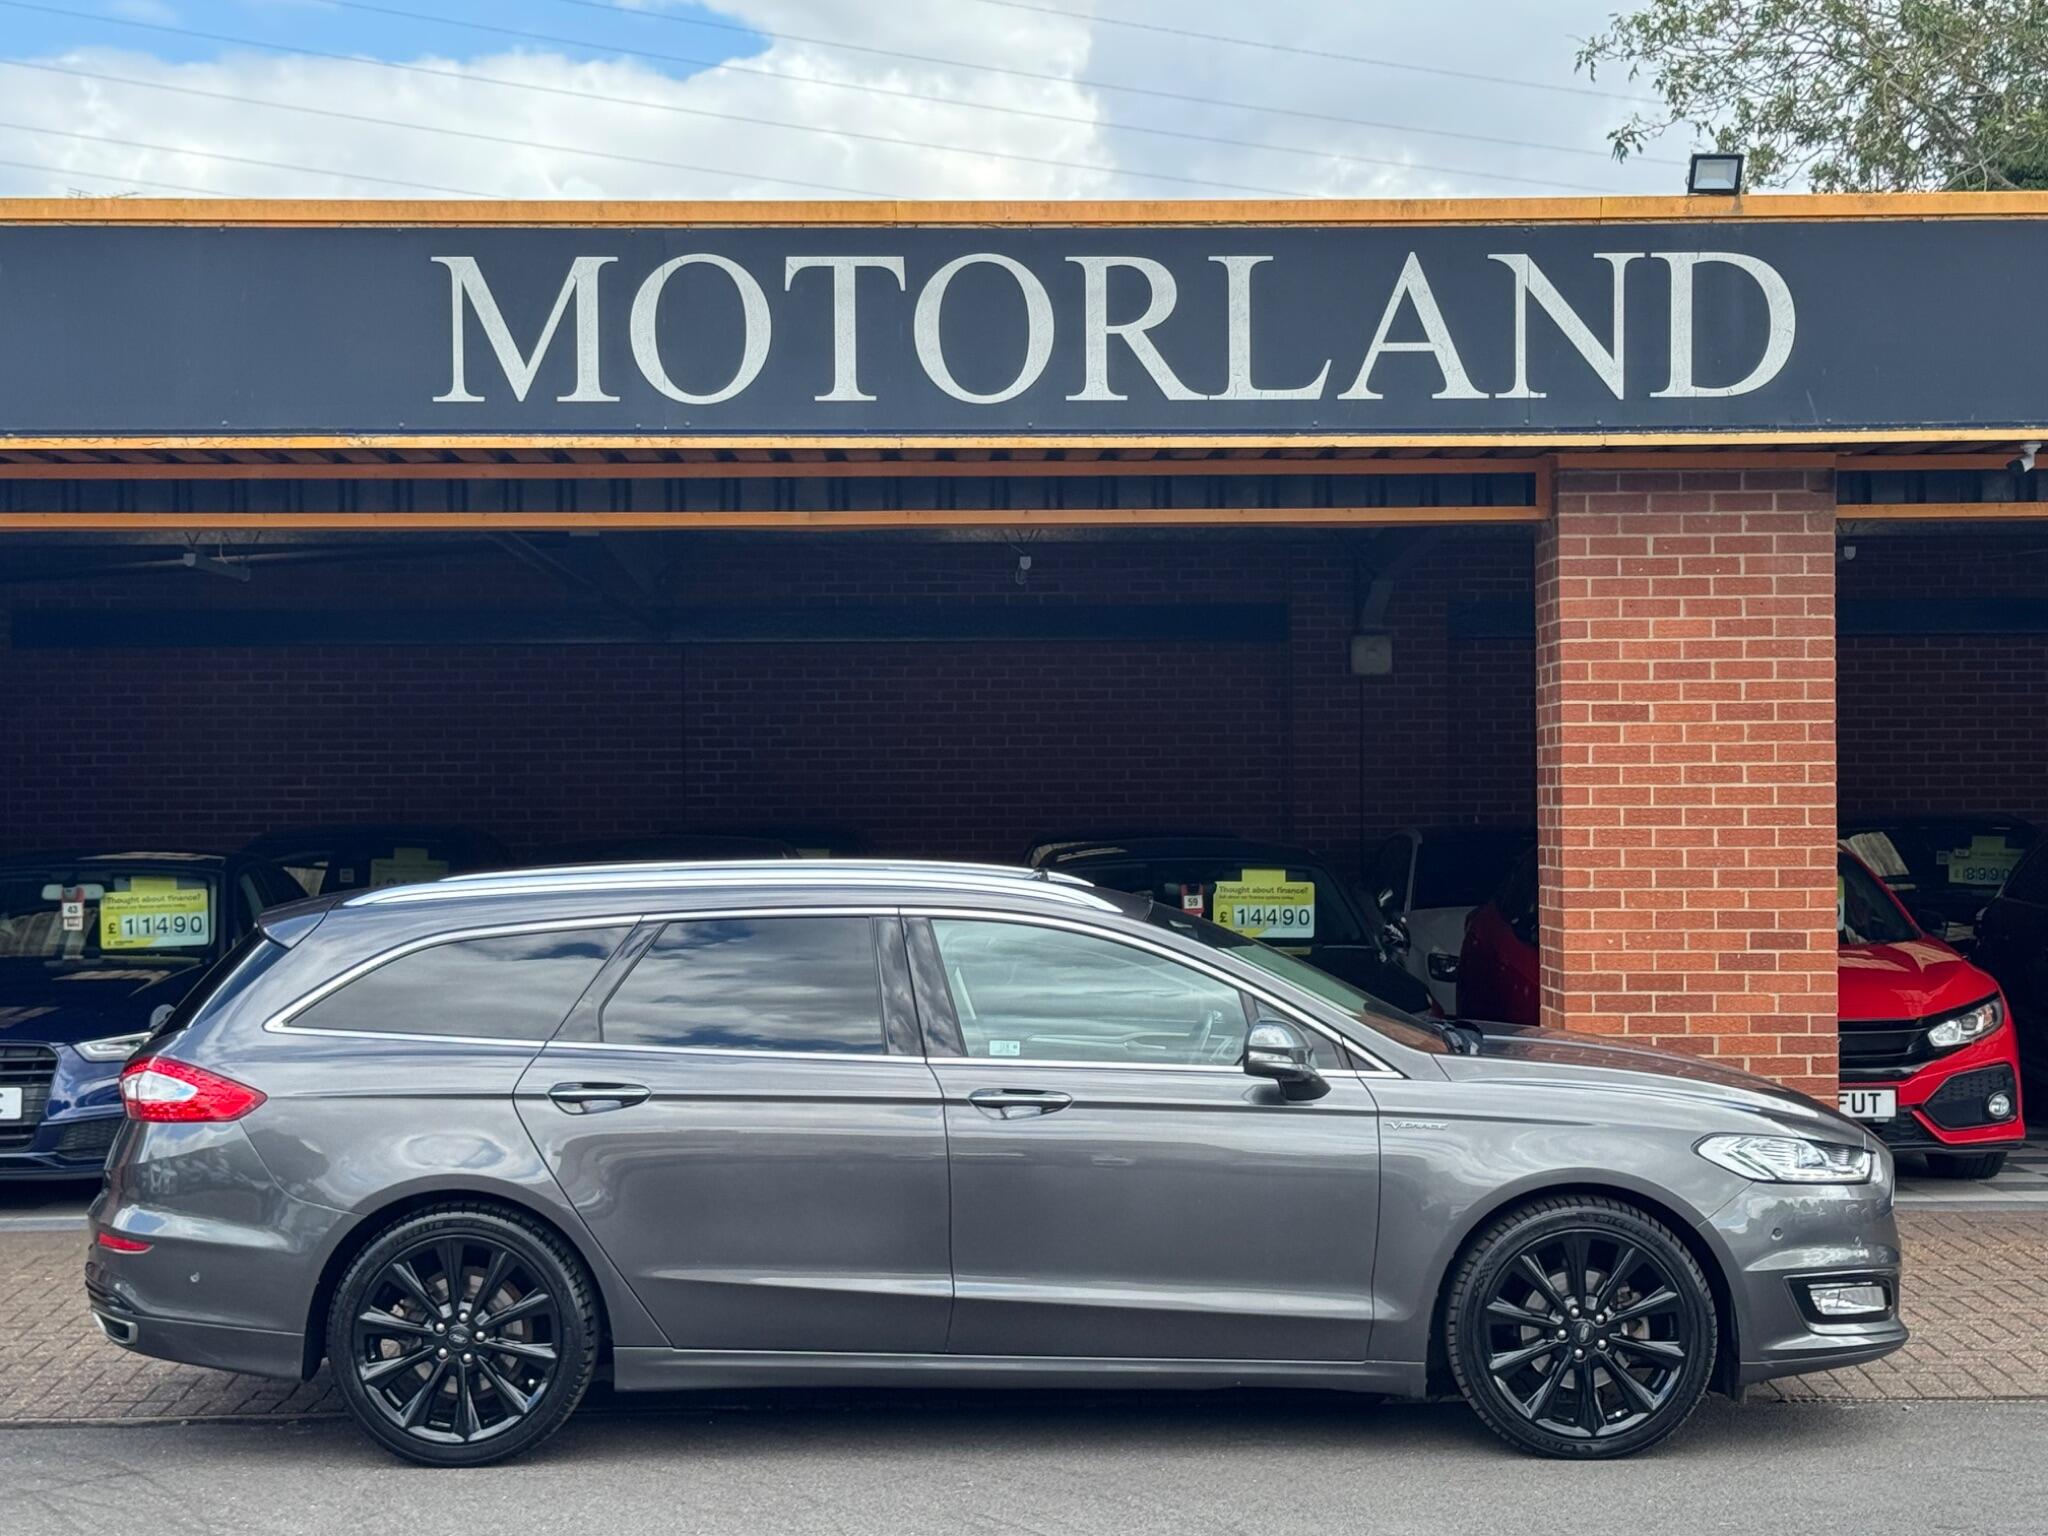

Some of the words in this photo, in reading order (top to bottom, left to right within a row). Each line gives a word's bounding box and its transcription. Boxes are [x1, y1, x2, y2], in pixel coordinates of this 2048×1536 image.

[431, 251, 1797, 403] MOTORLAND
[1218, 885, 1250, 895] Thought
[1252, 886, 1274, 894] about
[1276, 886, 1309, 894] finance?
[124, 915, 202, 936] 11490
[1236, 908, 1310, 926] 14490
